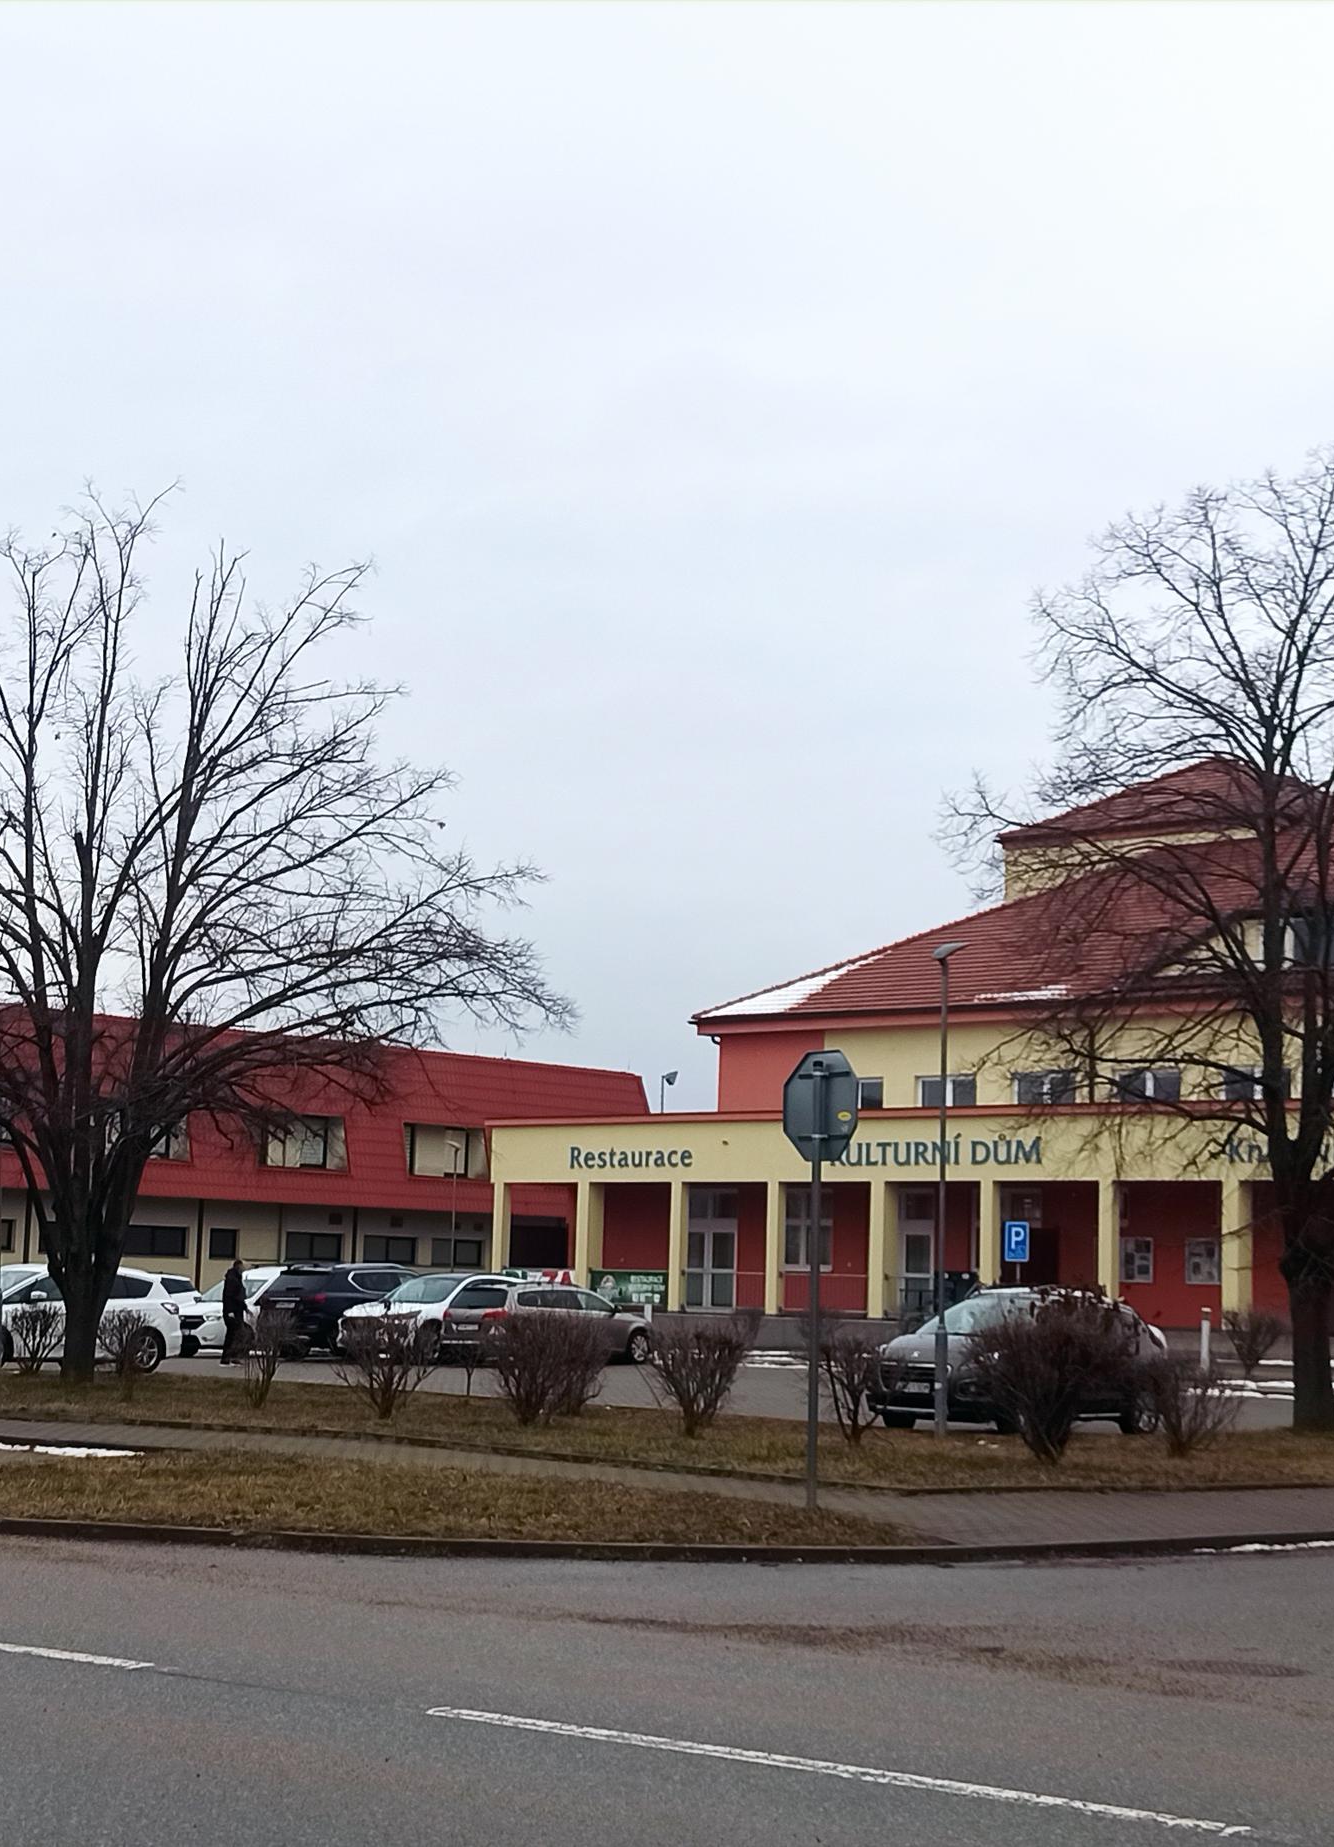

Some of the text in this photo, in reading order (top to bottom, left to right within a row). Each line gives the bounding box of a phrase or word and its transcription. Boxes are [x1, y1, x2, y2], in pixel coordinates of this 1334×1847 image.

[569, 1146, 693, 1169] Restaurace
[970, 1132, 1043, 1166] DŮM
[1011, 1227, 1025, 1250] P
